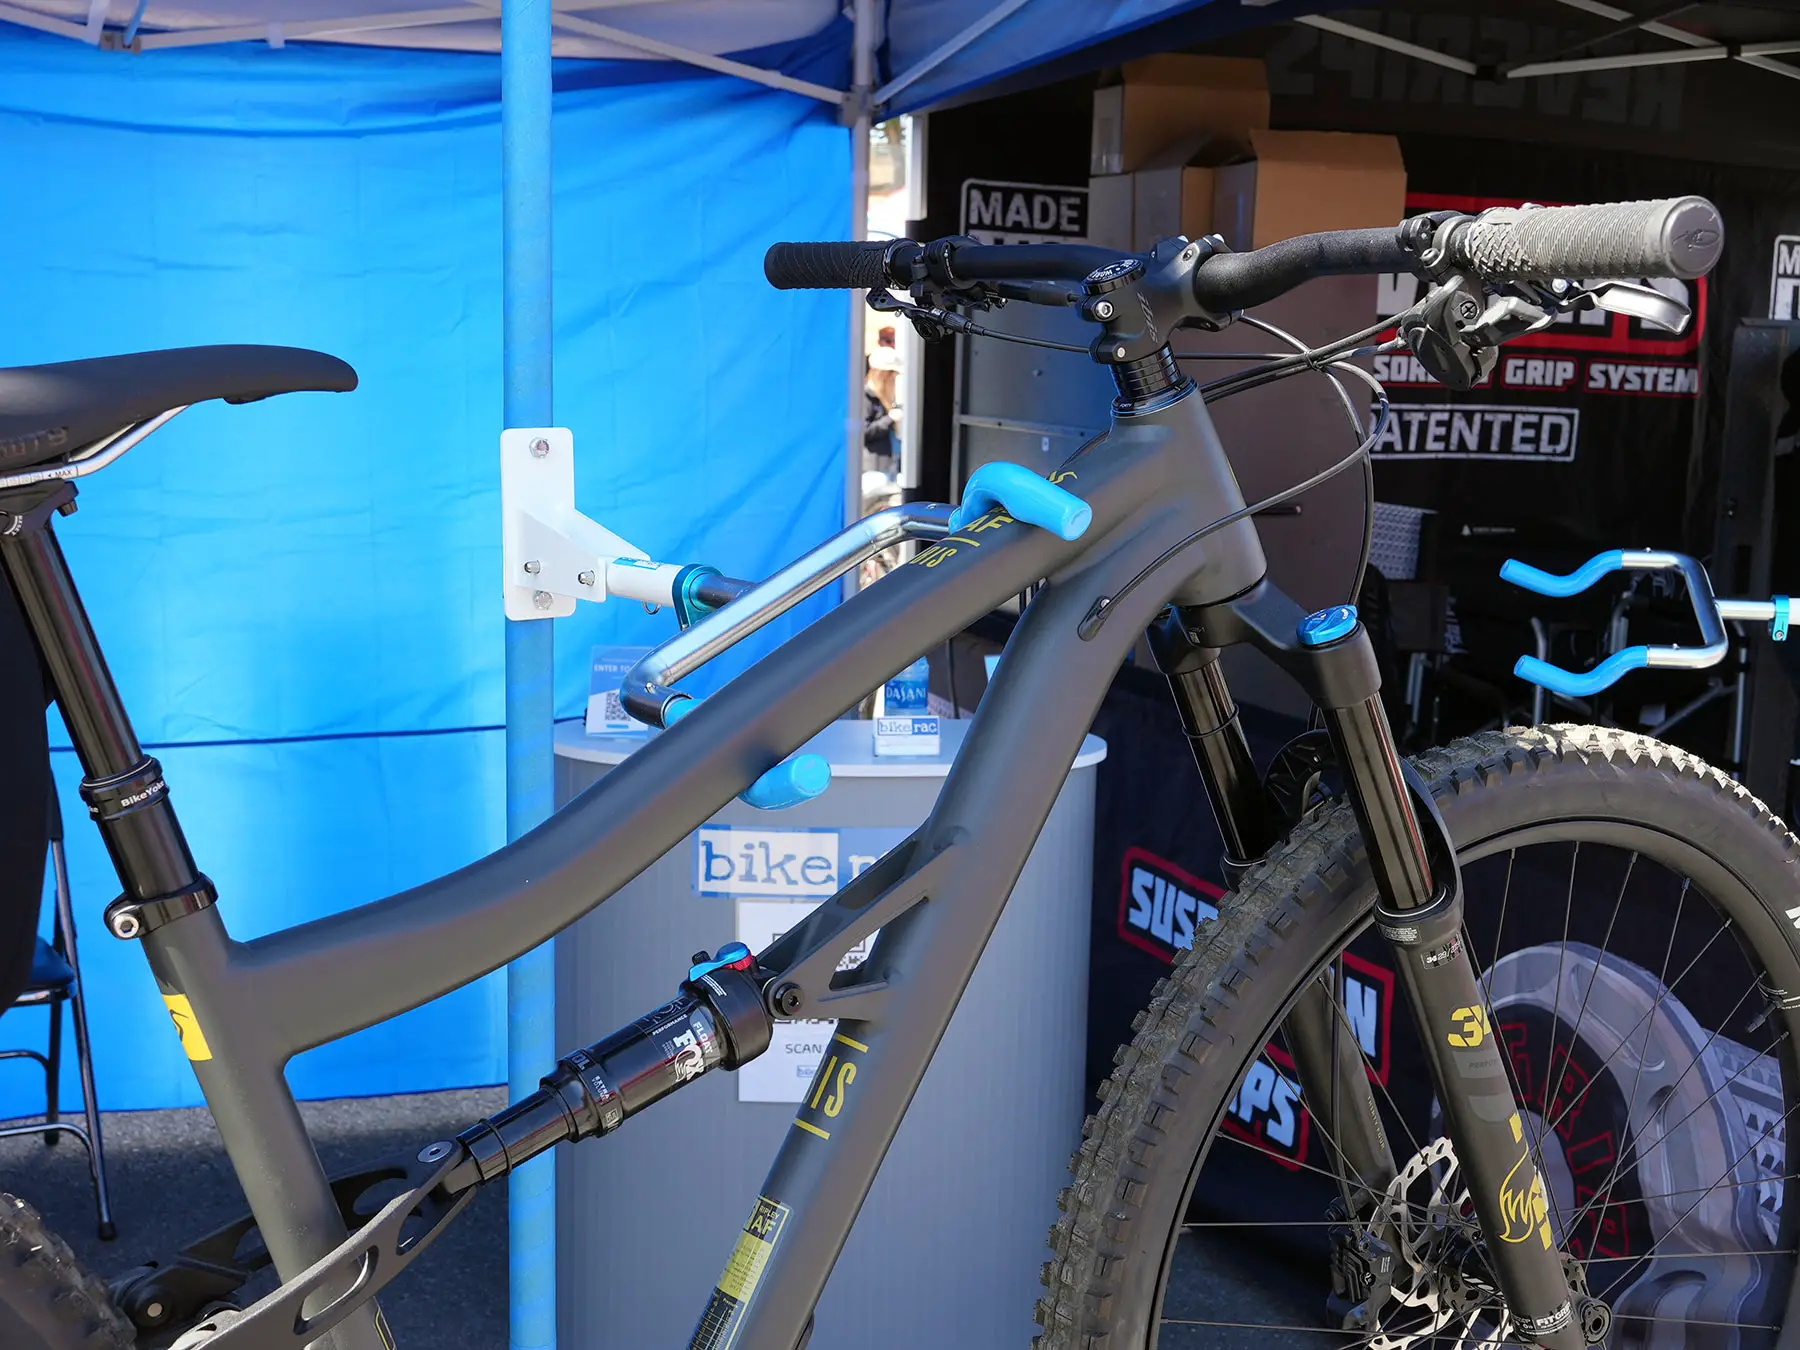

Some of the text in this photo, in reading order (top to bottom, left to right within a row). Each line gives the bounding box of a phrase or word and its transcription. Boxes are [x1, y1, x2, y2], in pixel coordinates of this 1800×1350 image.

[968, 188, 1082, 232] MADE
[1504, 358, 1576, 387] GRIP
[1587, 362, 1699, 394] SYSTEM
[886, 685, 926, 703] DASANI
[120, 779, 165, 808] BikeYok
[700, 840, 836, 887] bike
[652, 1013, 688, 1036] PERFORMANCE
[693, 1021, 714, 1054] FLOAT
[785, 1043, 822, 1054] SCAN
[751, 1214, 777, 1236] AF
